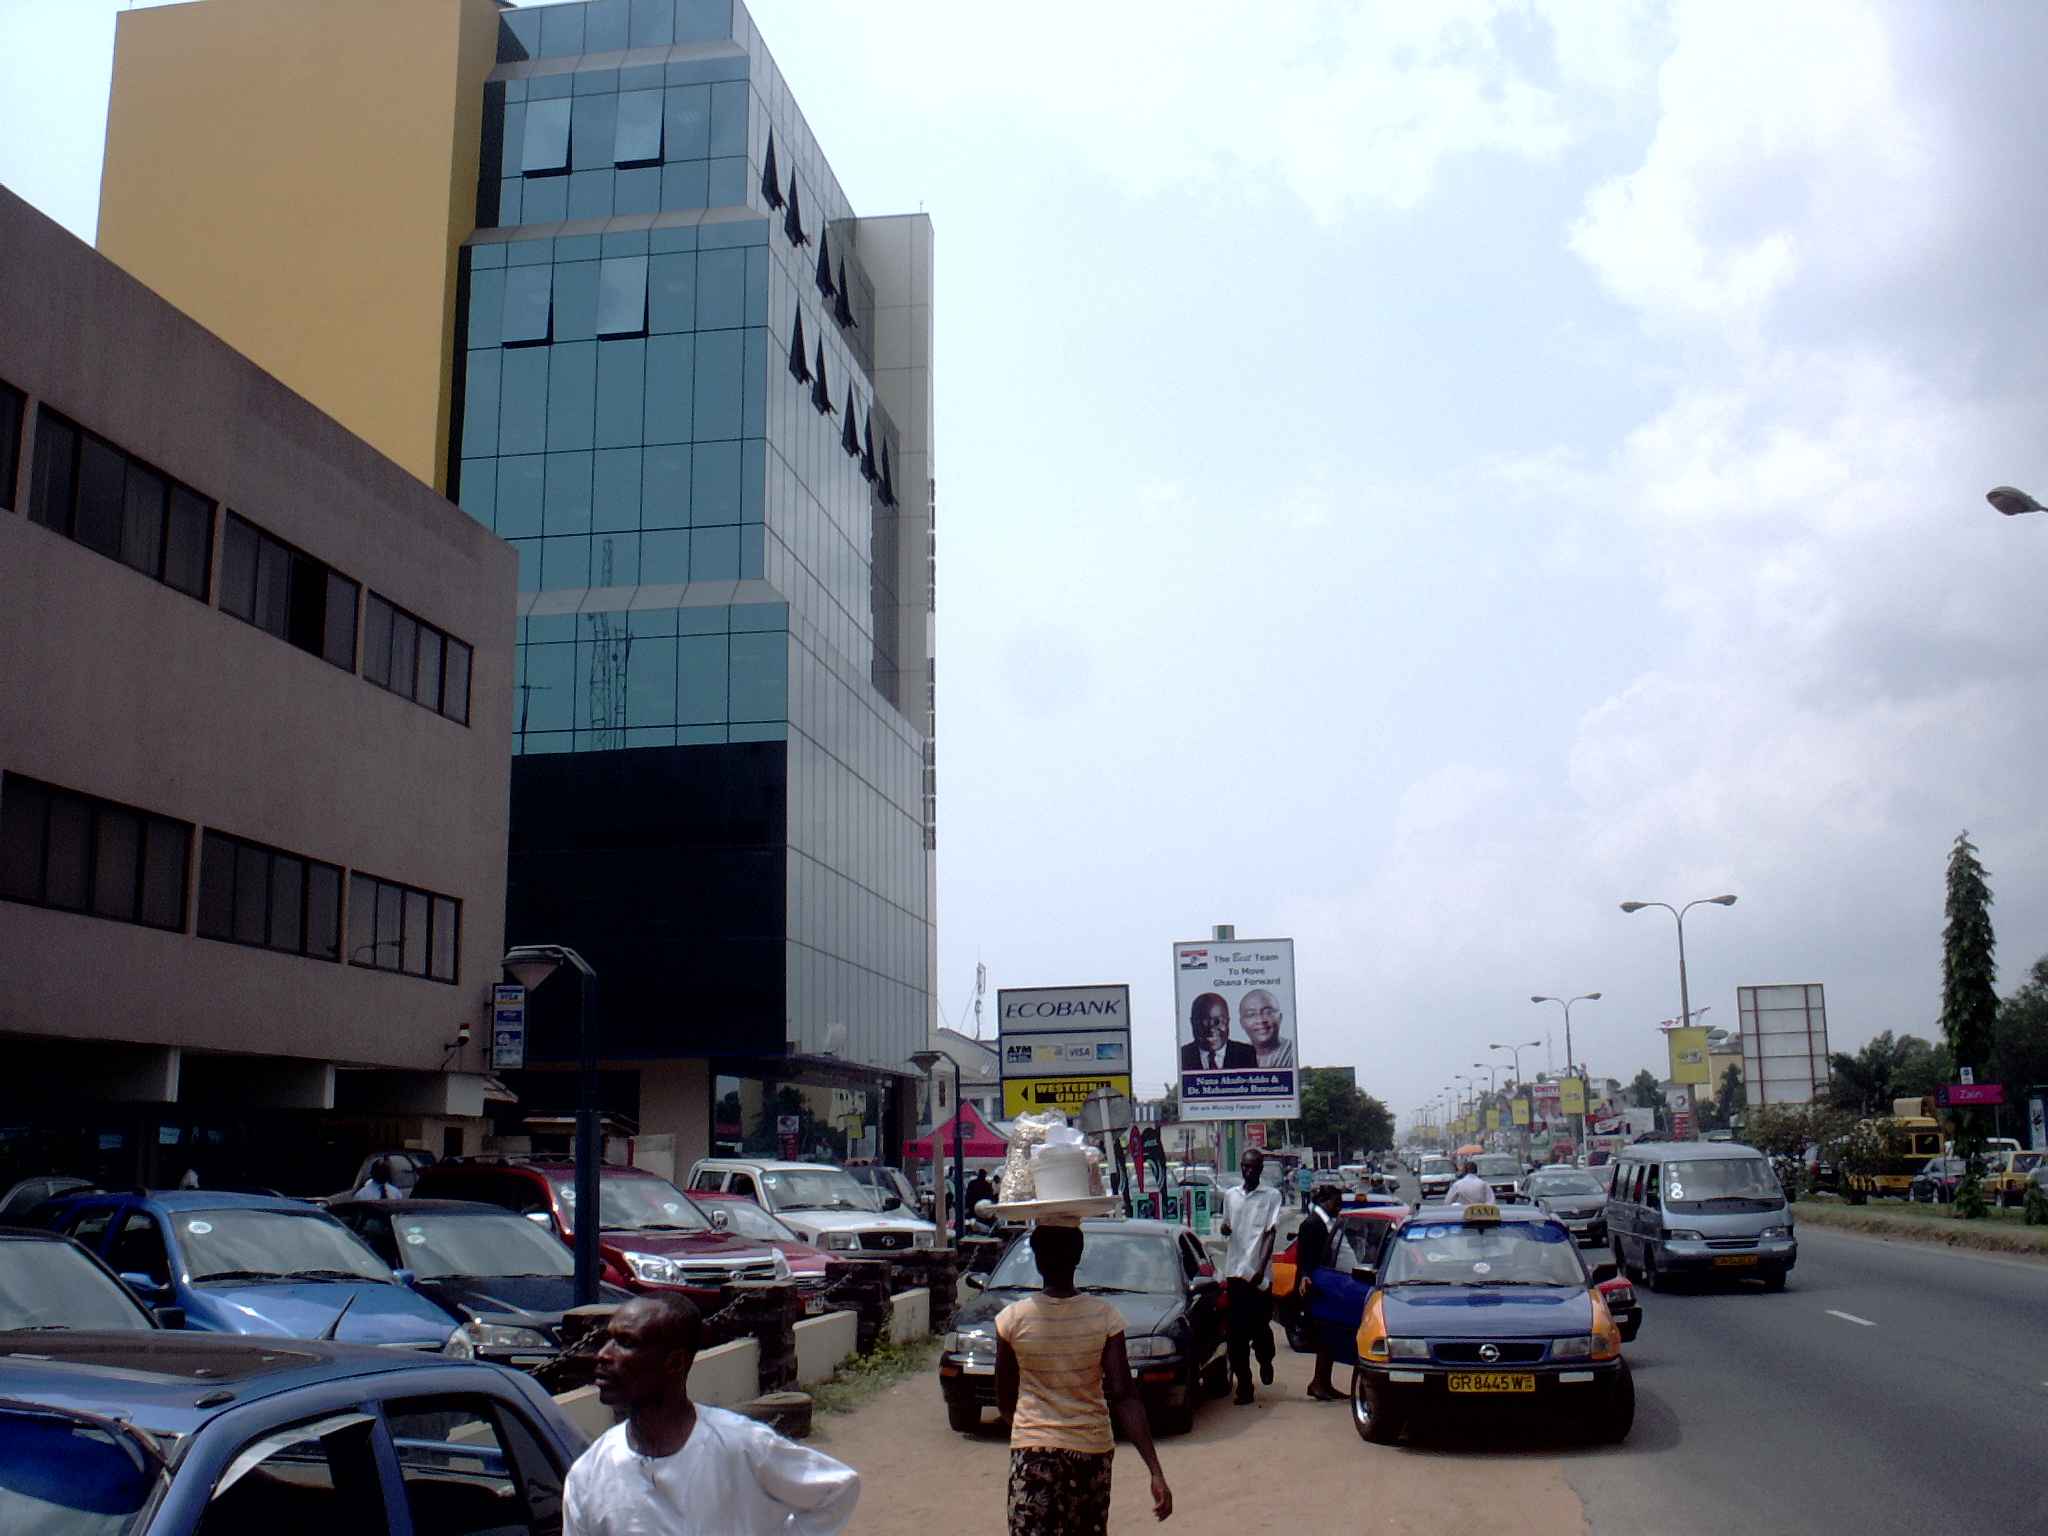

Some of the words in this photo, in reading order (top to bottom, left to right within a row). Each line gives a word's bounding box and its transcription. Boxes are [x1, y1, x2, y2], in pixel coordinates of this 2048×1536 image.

[1213, 979, 1241, 987] Ghana
[1006, 1000, 1120, 1018] ECOBANK
[1008, 1046, 1032, 1054] ATM
[1070, 1048, 1090, 1057] VISA
[1036, 1082, 1097, 1093] WESTERN
[1056, 1093, 1089, 1102] UNIO
[1450, 1375, 1471, 1390] GR
[1474, 1375, 1509, 1390] 8445
